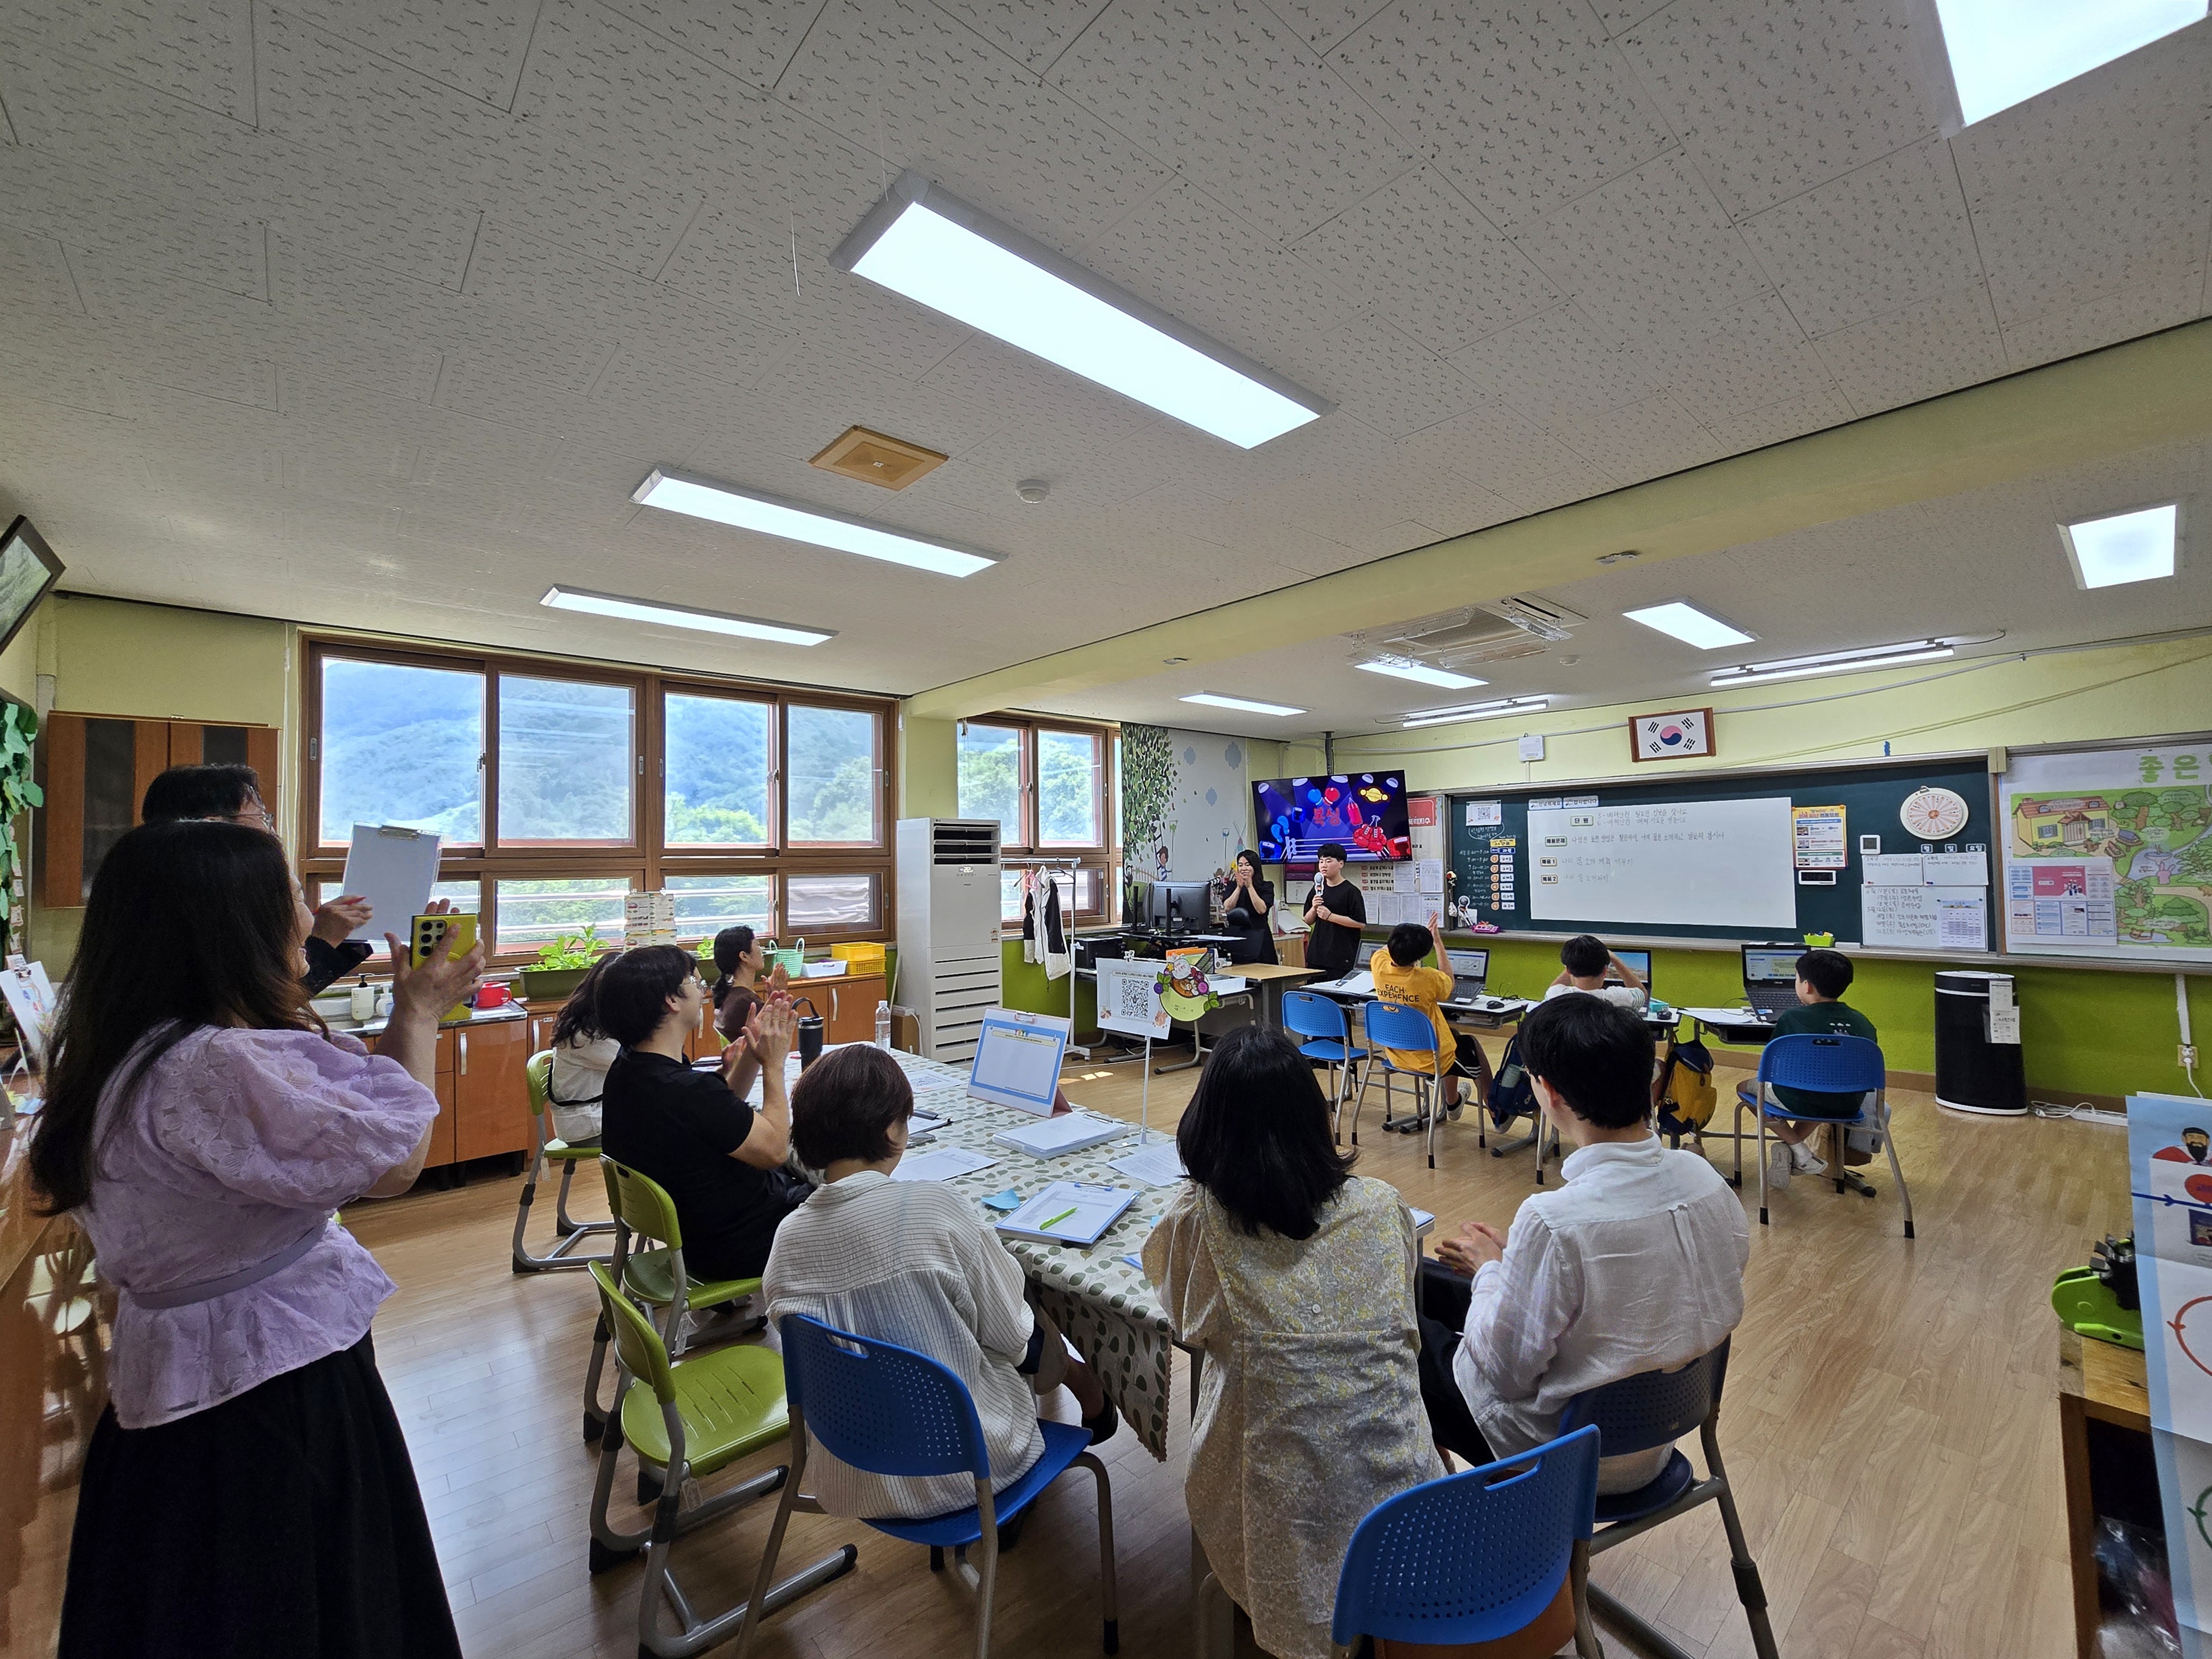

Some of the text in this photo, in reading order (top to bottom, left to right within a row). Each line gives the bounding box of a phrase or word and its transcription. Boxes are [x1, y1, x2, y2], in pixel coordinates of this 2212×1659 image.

[2138, 755, 2200, 783] 좋은
[1314, 807, 1340, 827] 복싱
[1707, 831, 1724, 841] 봅시다
[1385, 984, 1405, 994] EACH
